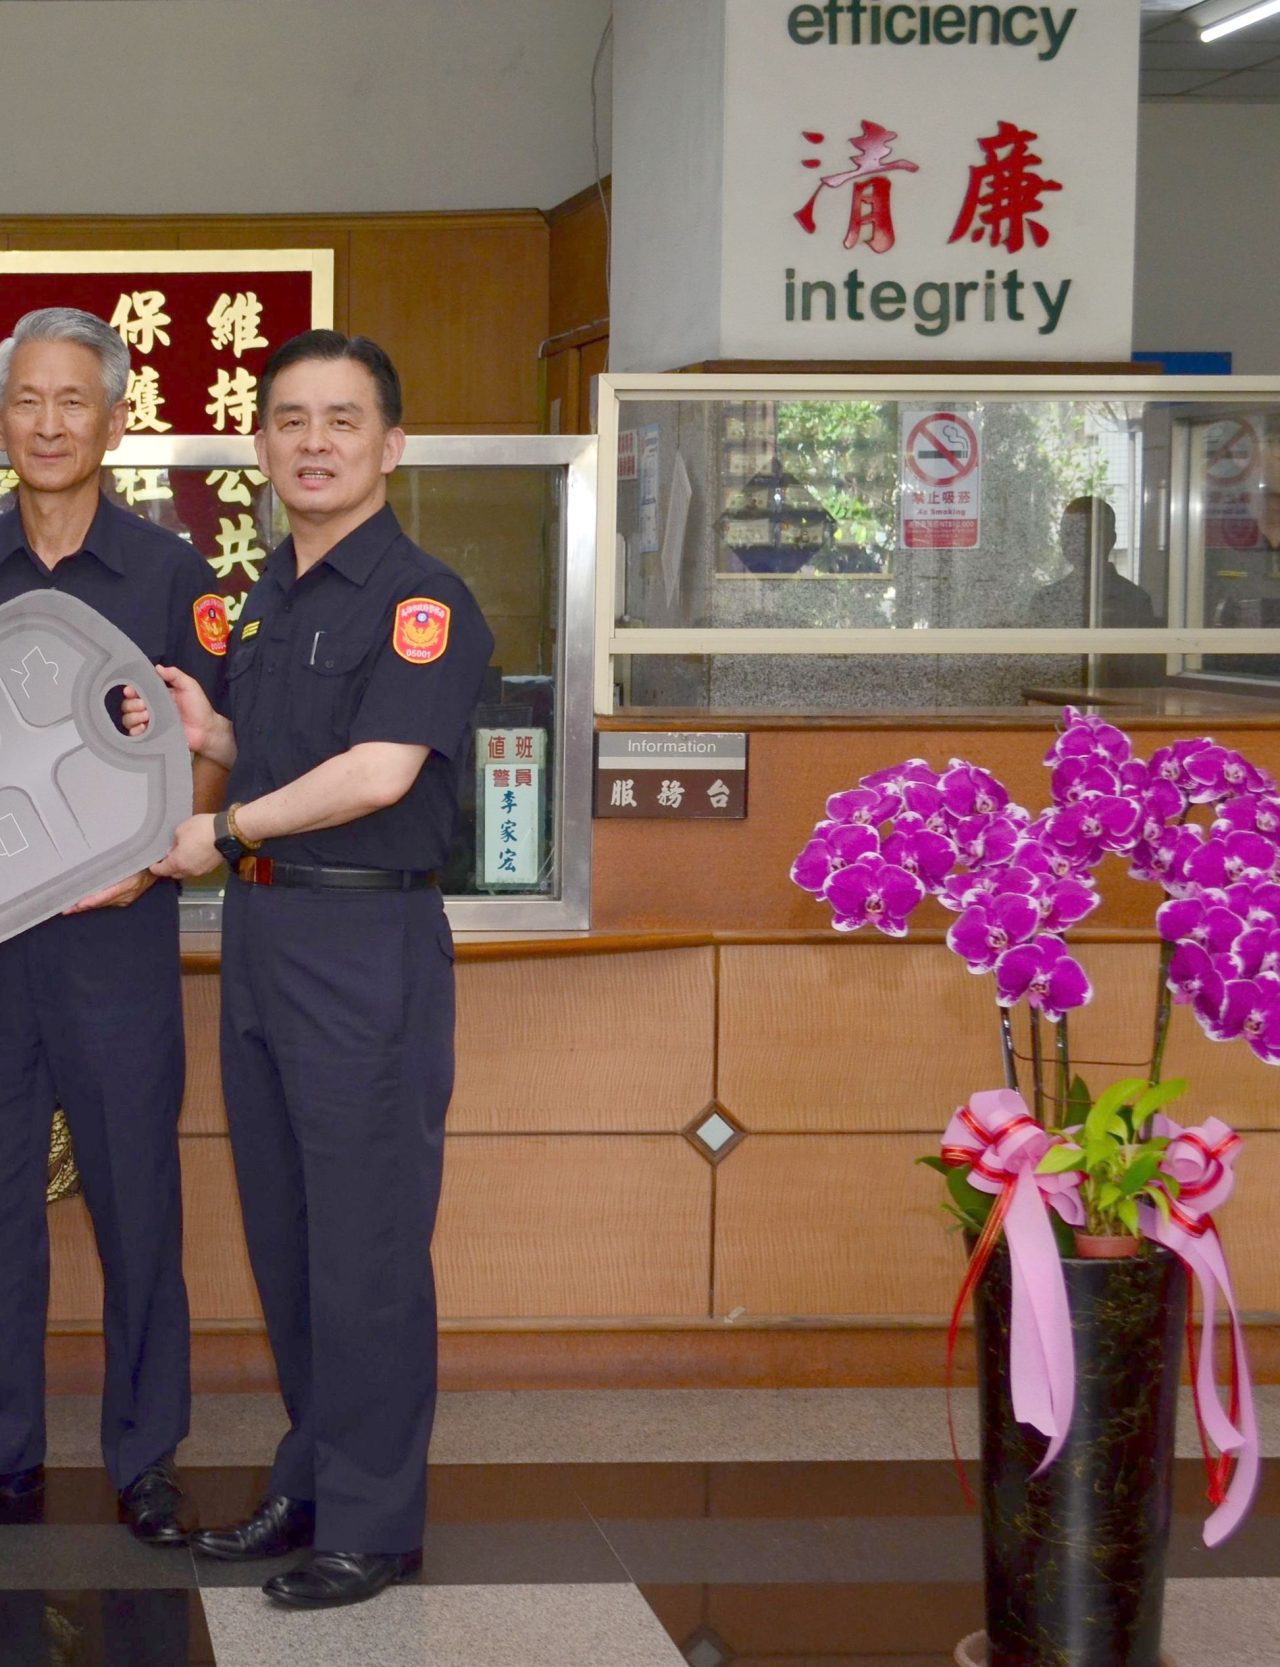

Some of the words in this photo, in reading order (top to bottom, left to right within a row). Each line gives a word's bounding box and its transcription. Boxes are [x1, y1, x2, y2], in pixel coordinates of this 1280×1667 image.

[787, 0, 1078, 61] efficiency
[793, 119, 1063, 254] 清廉
[784, 268, 1072, 337] integrity
[109, 290, 173, 519] 保護社
[628, 739, 716, 753] Information
[492, 768, 532, 788] 警員
[610, 778, 730, 809] 服務台
